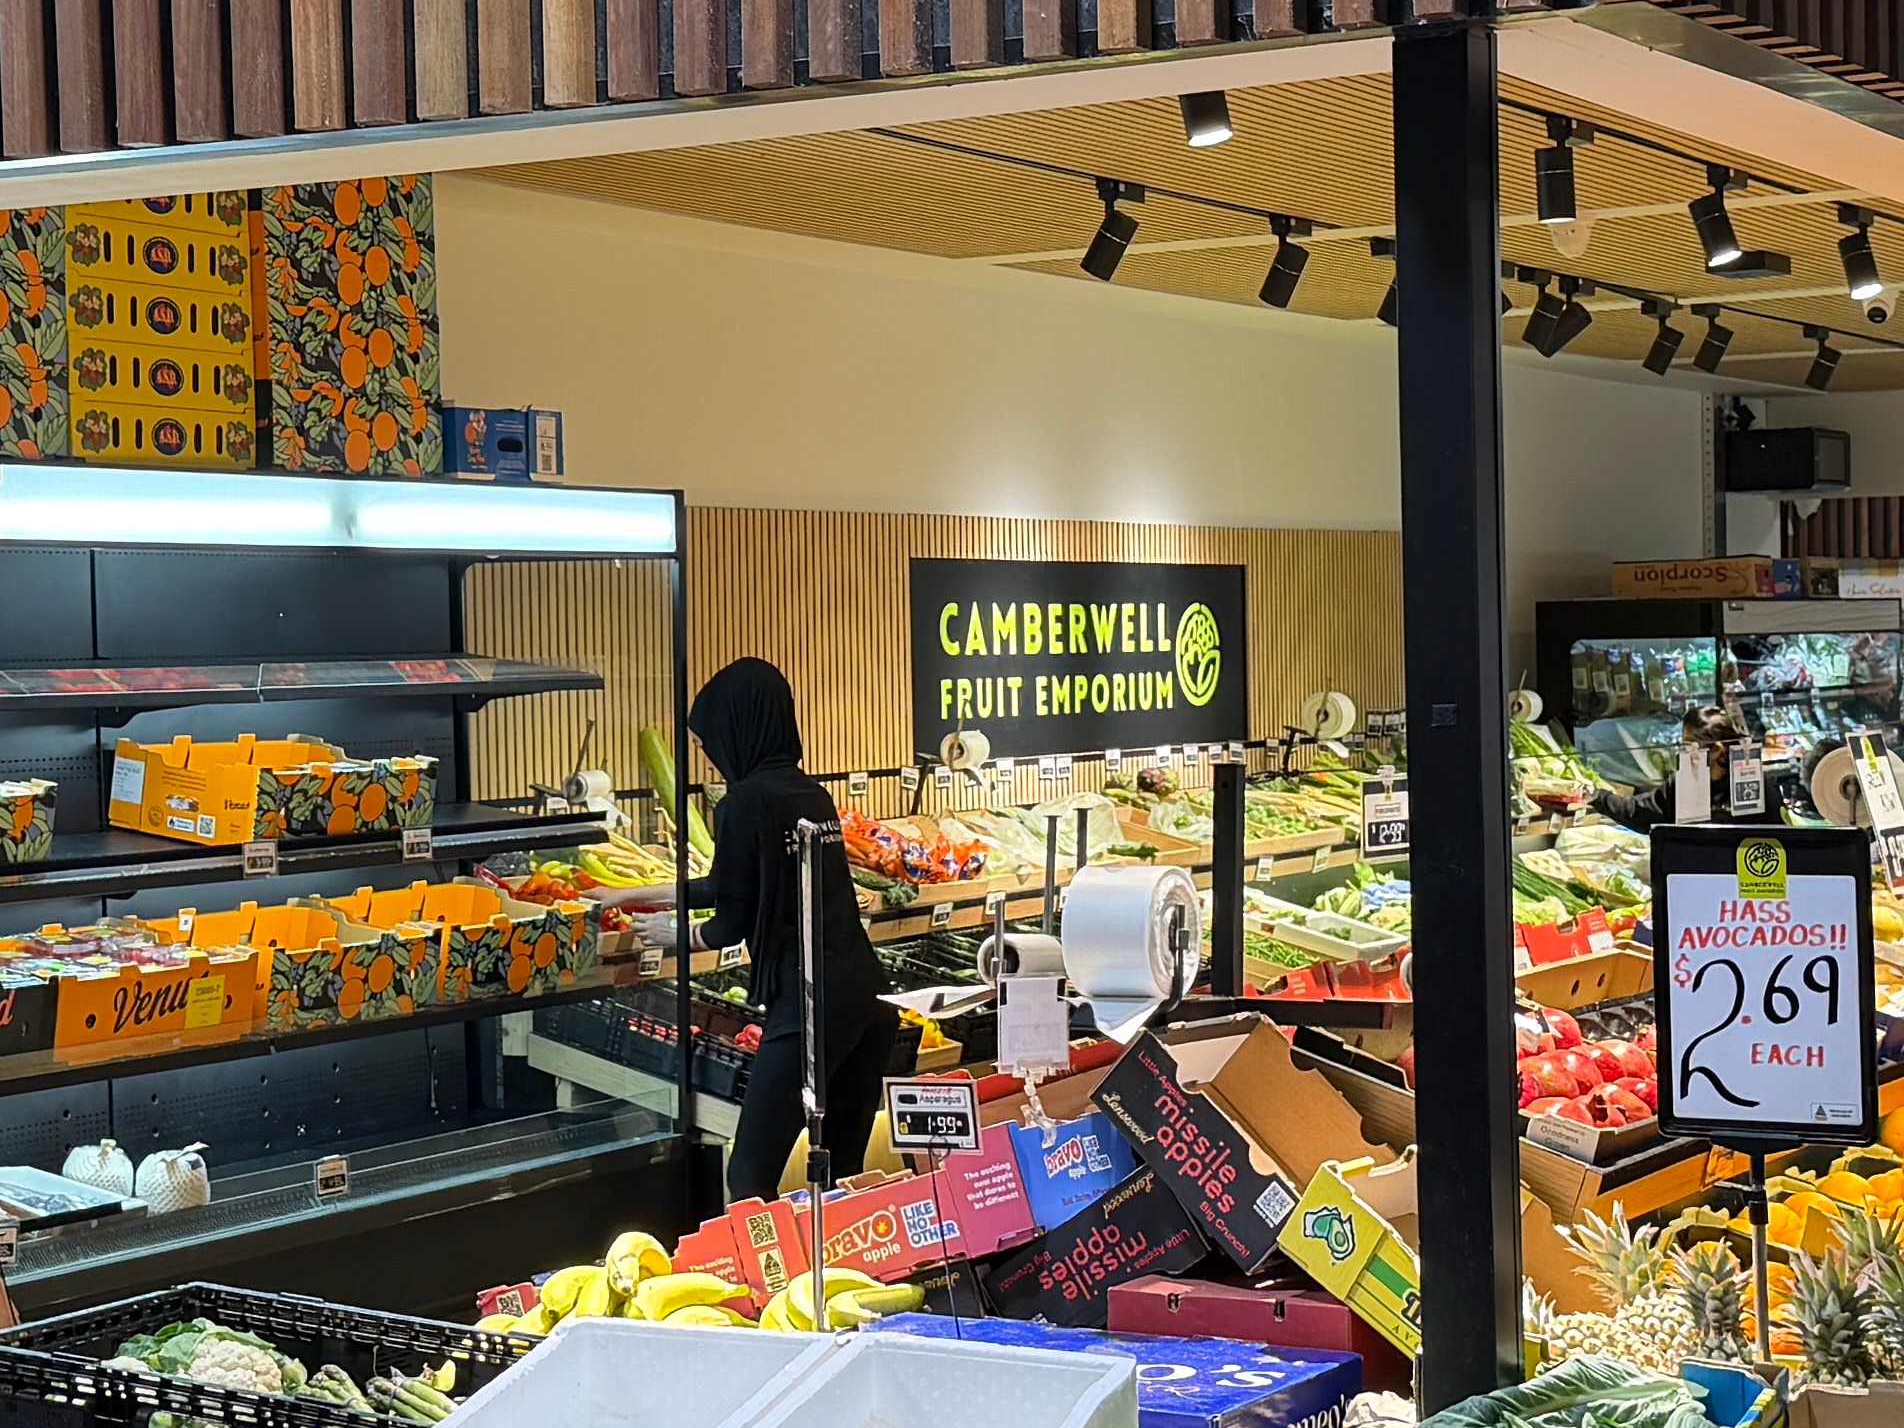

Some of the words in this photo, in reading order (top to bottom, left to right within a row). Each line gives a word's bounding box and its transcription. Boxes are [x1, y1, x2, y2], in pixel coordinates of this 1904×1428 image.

[1633, 566, 1728, 584] Scorpion
[939, 601, 1172, 656] CAMBERWELL
[940, 676, 1023, 720] FRUIT
[1035, 671, 1174, 716] EMPORIUM
[1678, 923, 1847, 951] AVOCADOS!!
[1719, 900, 1792, 924] HASS
[113, 972, 208, 1034] Venu
[1680, 954, 1839, 1108] 2.69
[1751, 1042, 1824, 1068] EACH
[1138, 1051, 1160, 1077] Little
[1158, 1075, 1187, 1107] Apples
[927, 1116, 957, 1135] 1.99
[1102, 1092, 1155, 1145] Lenswood
[1154, 1094, 1238, 1185] missile
[1156, 1126, 1235, 1214] apples
[904, 1201, 933, 1220] LIKE
[907, 1216, 929, 1233] NO
[910, 1223, 959, 1246] OTHER
[1199, 1200, 1216, 1222] Big
[1215, 1219, 1251, 1258] Crunch!
[863, 1242, 901, 1263] apple
[1039, 1224, 1122, 1290] apples
[1062, 1232, 1147, 1301] missile
